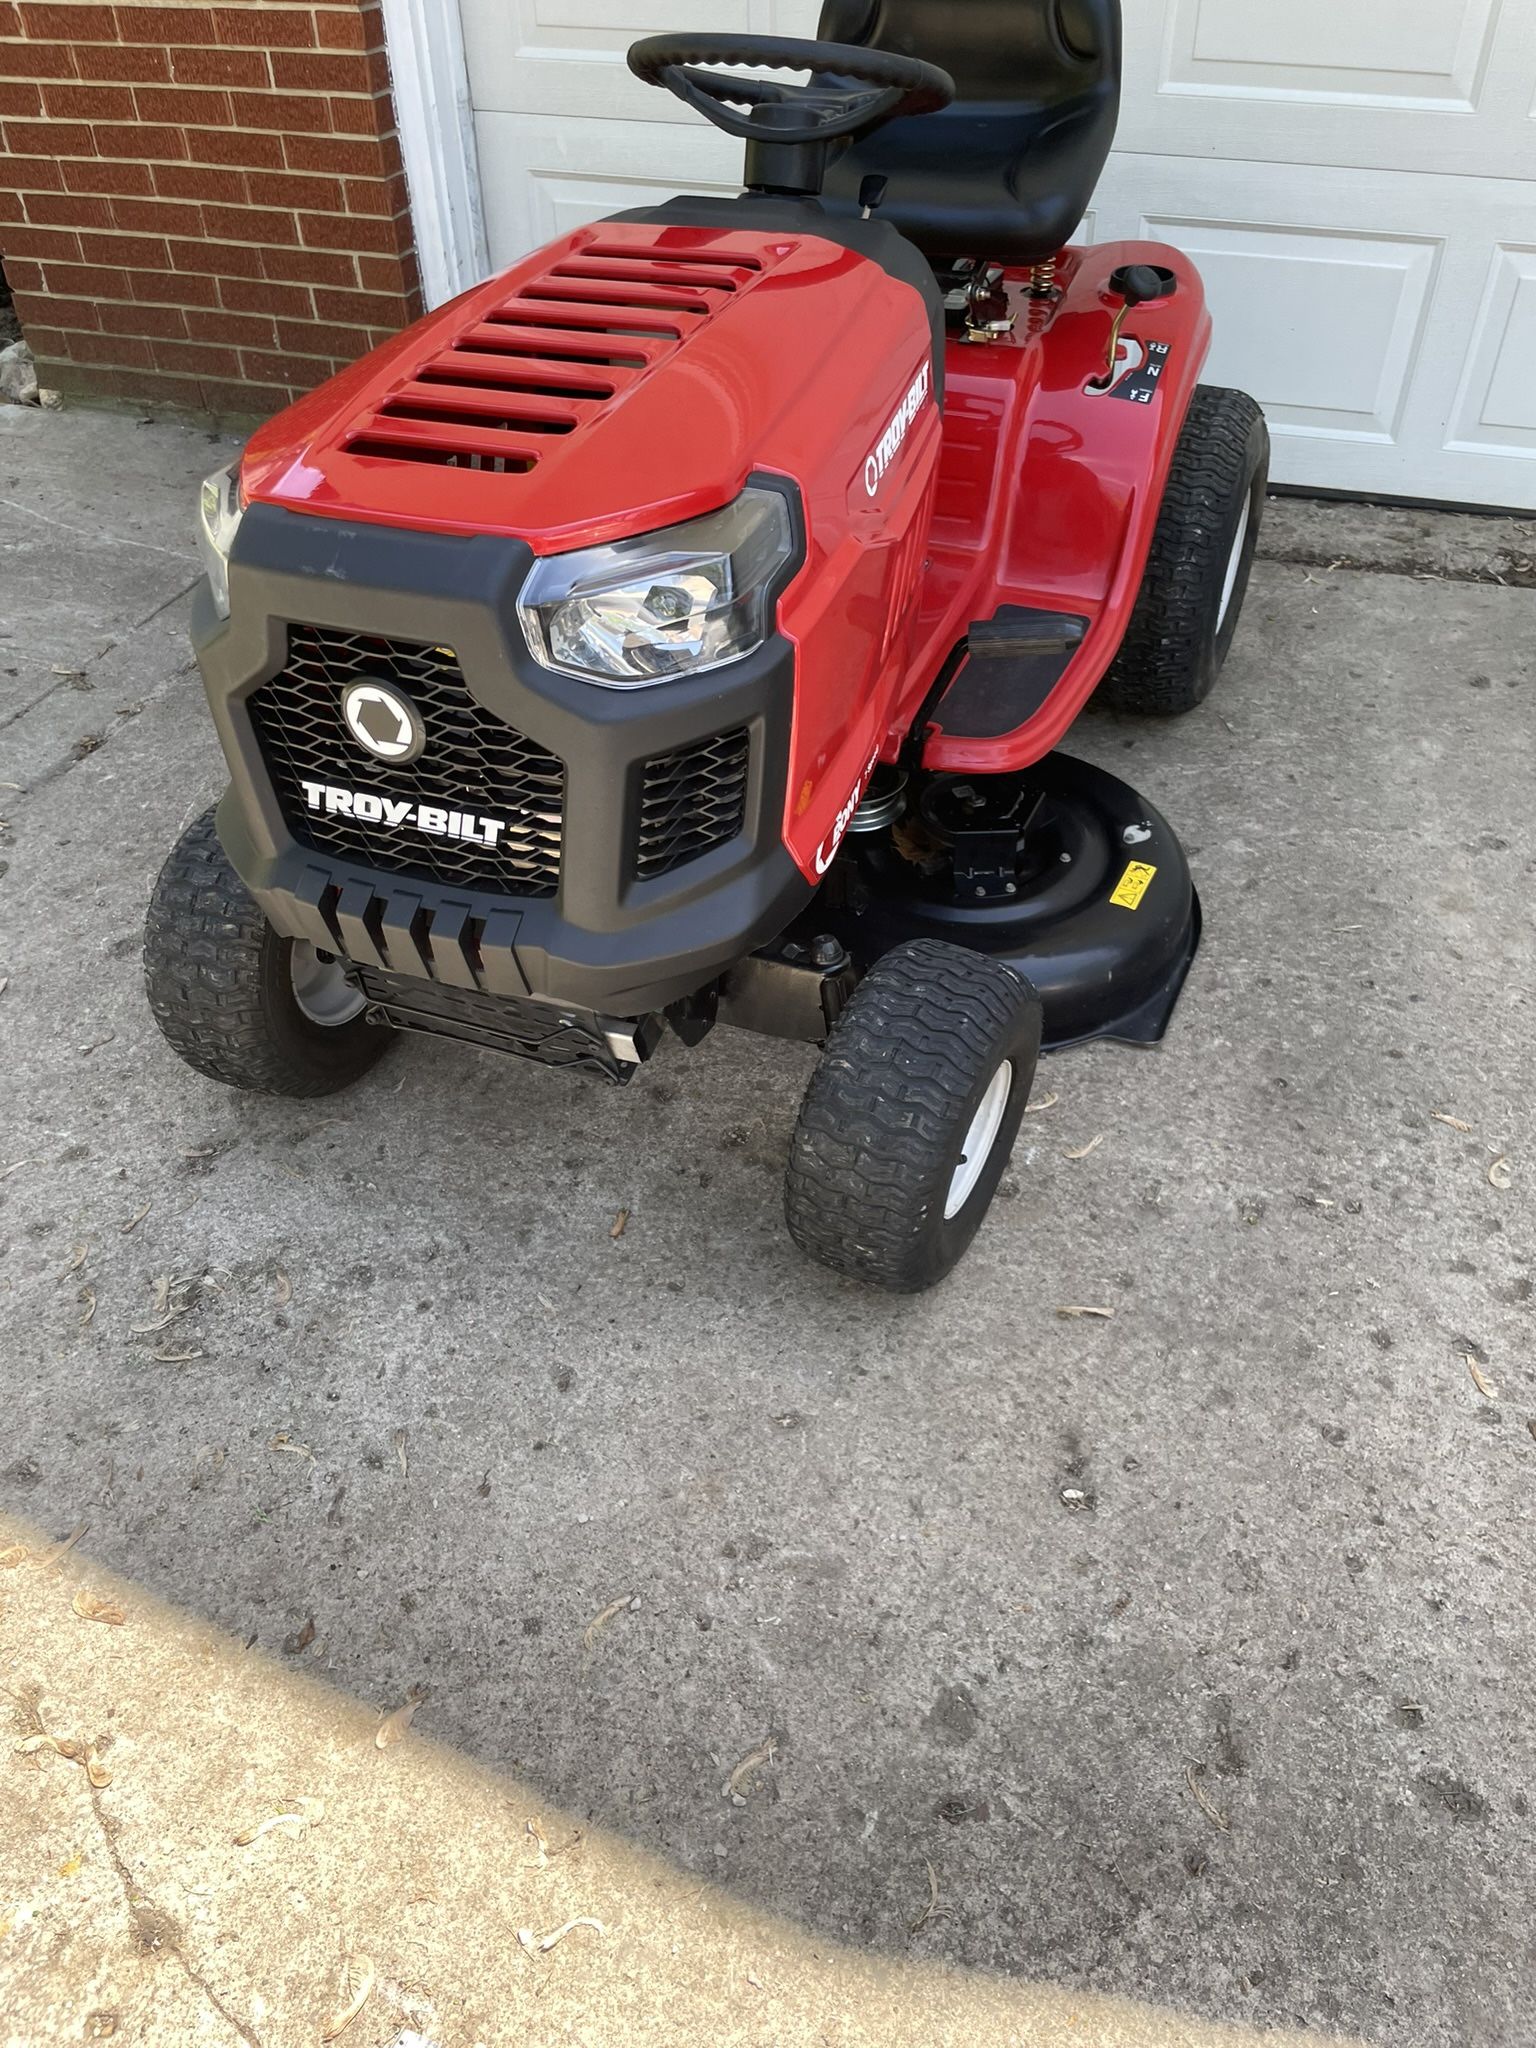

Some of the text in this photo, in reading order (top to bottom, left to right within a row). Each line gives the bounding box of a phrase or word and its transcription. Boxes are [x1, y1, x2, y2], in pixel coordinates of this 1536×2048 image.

[1155, 344, 1169, 354] R
[1147, 366, 1160, 377] N
[1138, 392, 1150, 403] F
[876, 360, 929, 478] TROY-BILT
[301, 780, 506, 847] TROY-BILT
